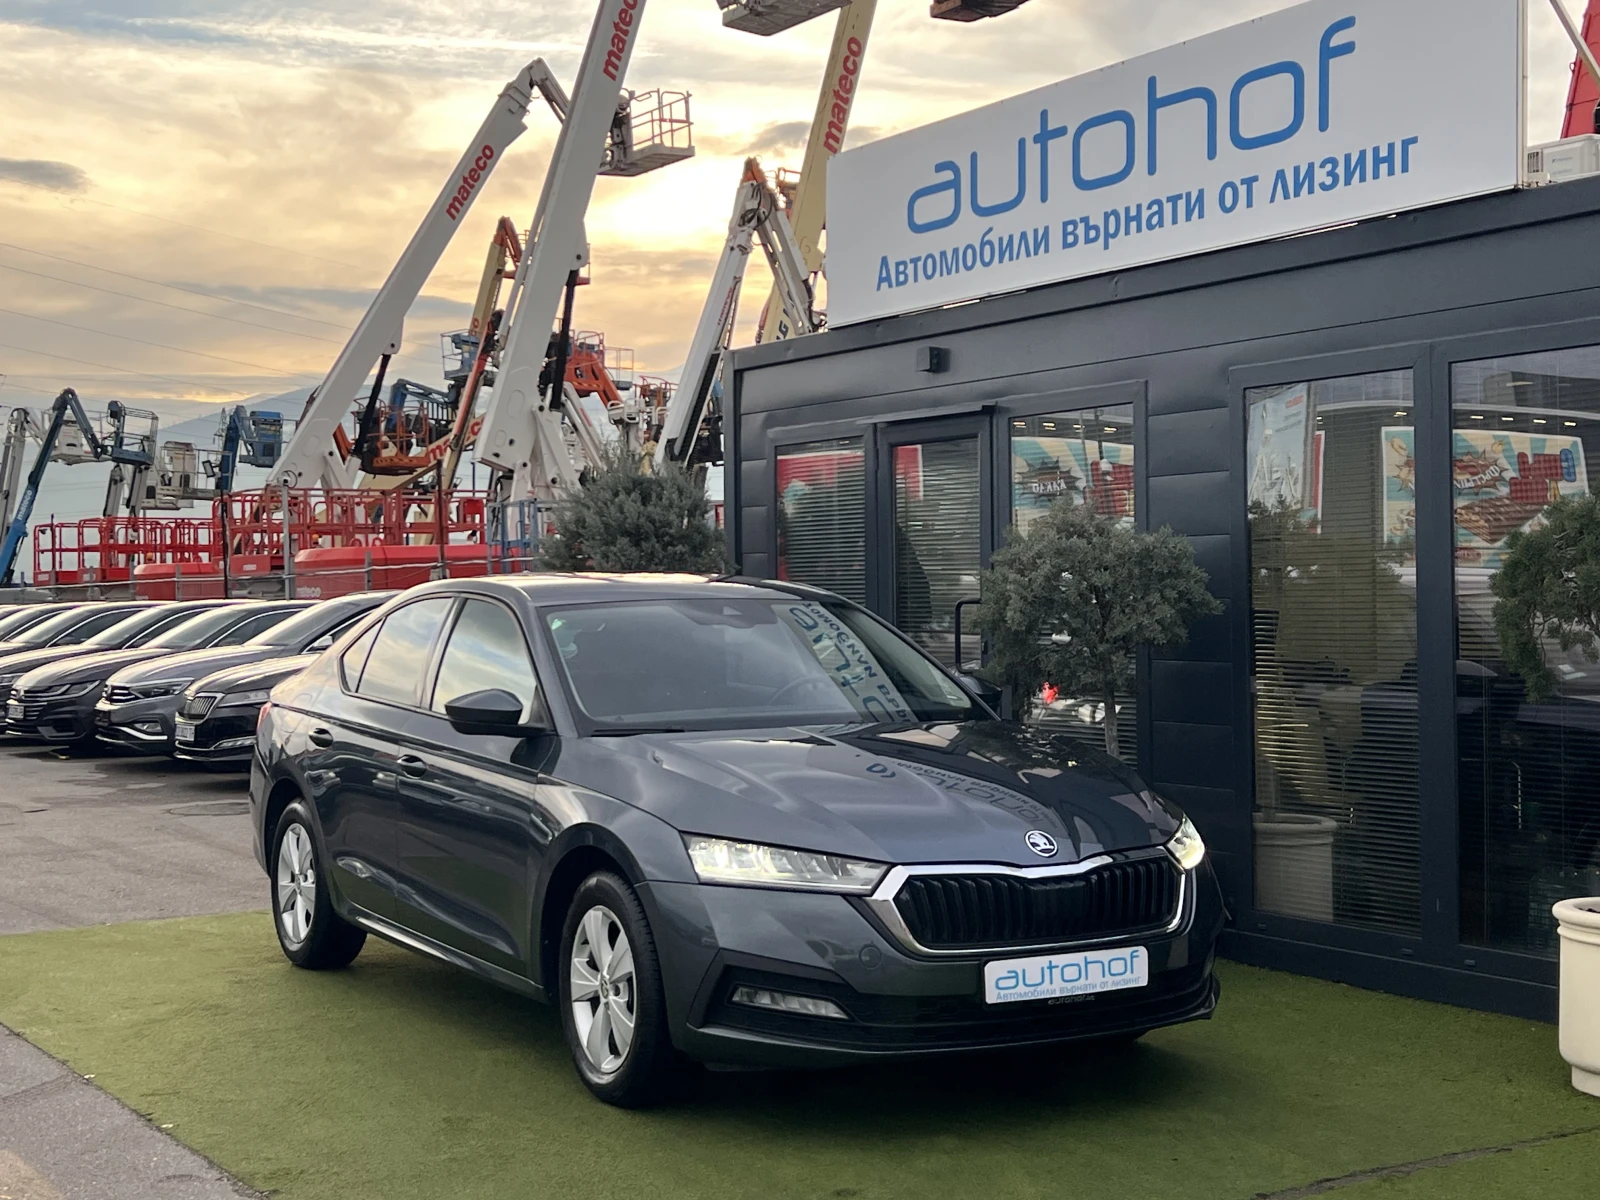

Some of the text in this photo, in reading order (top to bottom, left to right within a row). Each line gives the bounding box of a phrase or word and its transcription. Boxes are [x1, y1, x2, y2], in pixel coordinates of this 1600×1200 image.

[823, 36, 863, 154] mateco
[907, 16, 1356, 234] autohof
[445, 144, 495, 221] mateco
[877, 136, 1418, 289] Автомобили върнати от лизинг
[995, 949, 1140, 991] autohof
[996, 976, 1141, 1002] Автомобили върнати от лизинг
